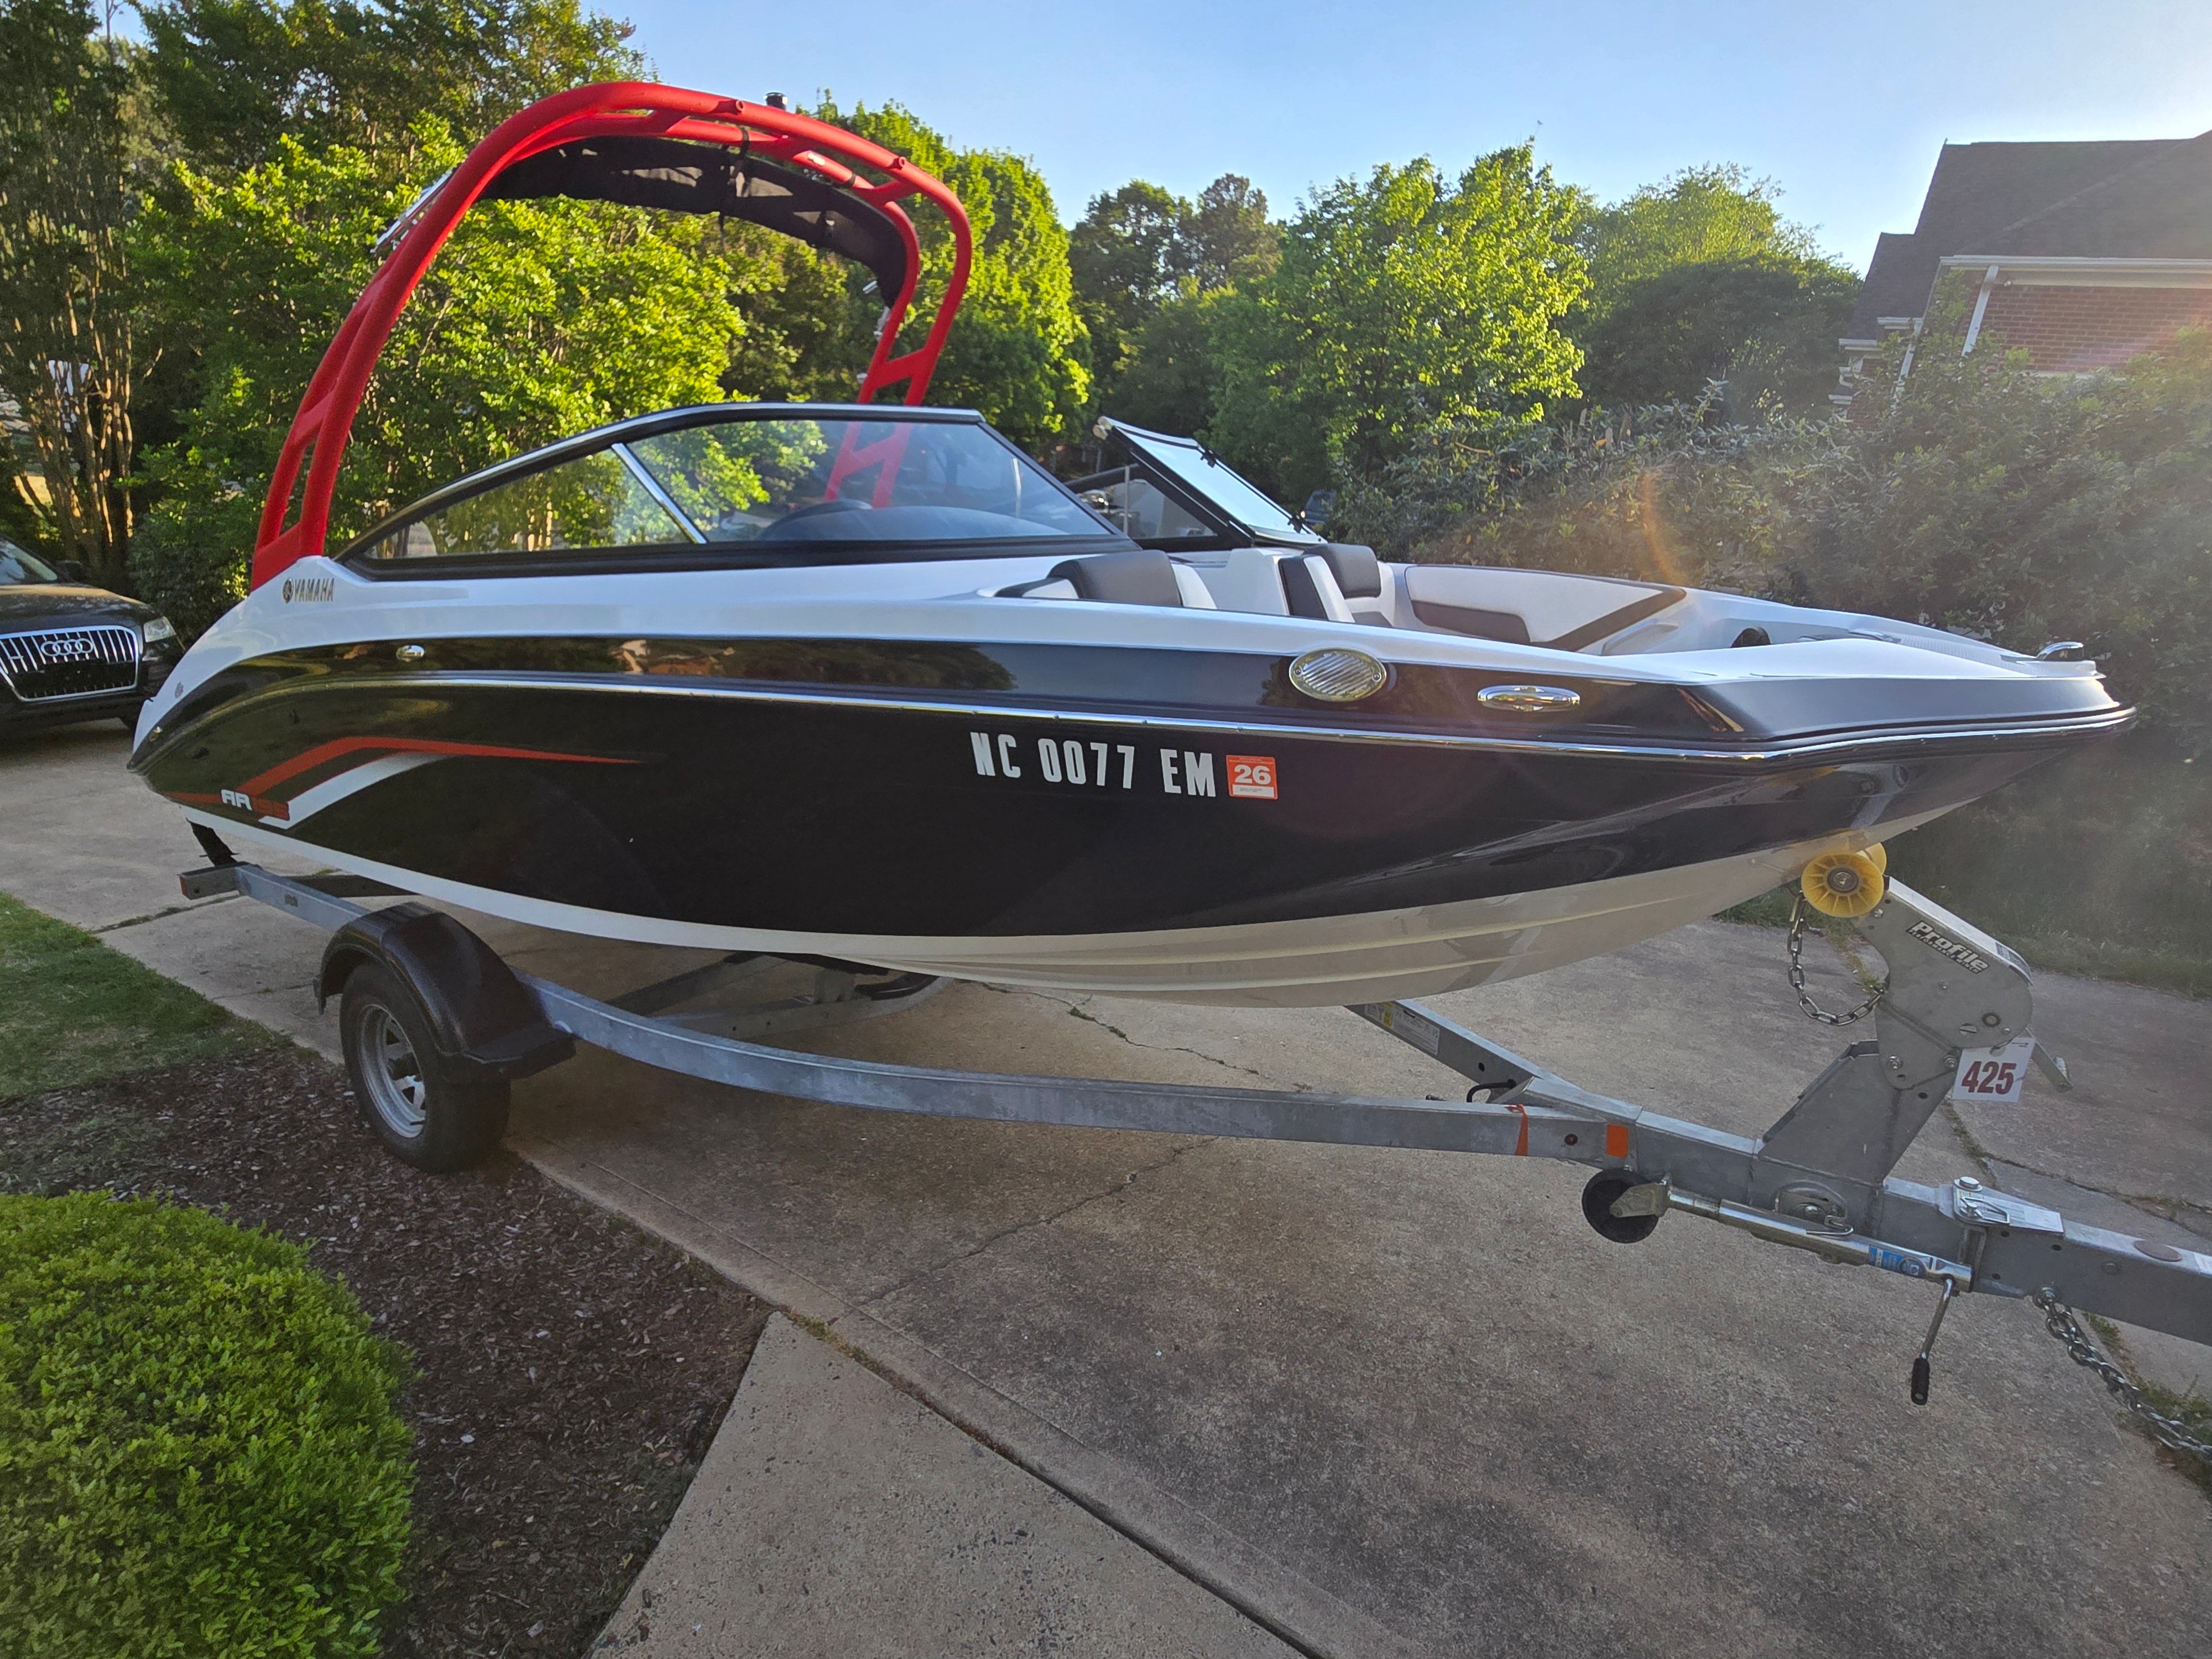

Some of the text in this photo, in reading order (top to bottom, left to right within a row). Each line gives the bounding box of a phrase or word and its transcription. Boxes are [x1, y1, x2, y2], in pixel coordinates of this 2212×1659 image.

[295, 578, 335, 602] YAMAHA
[970, 732, 1216, 797] NC 0077 EM
[1234, 764, 1271, 785] 26
[221, 789, 253, 811] AR
[1911, 921, 1989, 971] Profile
[1961, 1061, 2017, 1095] 425
